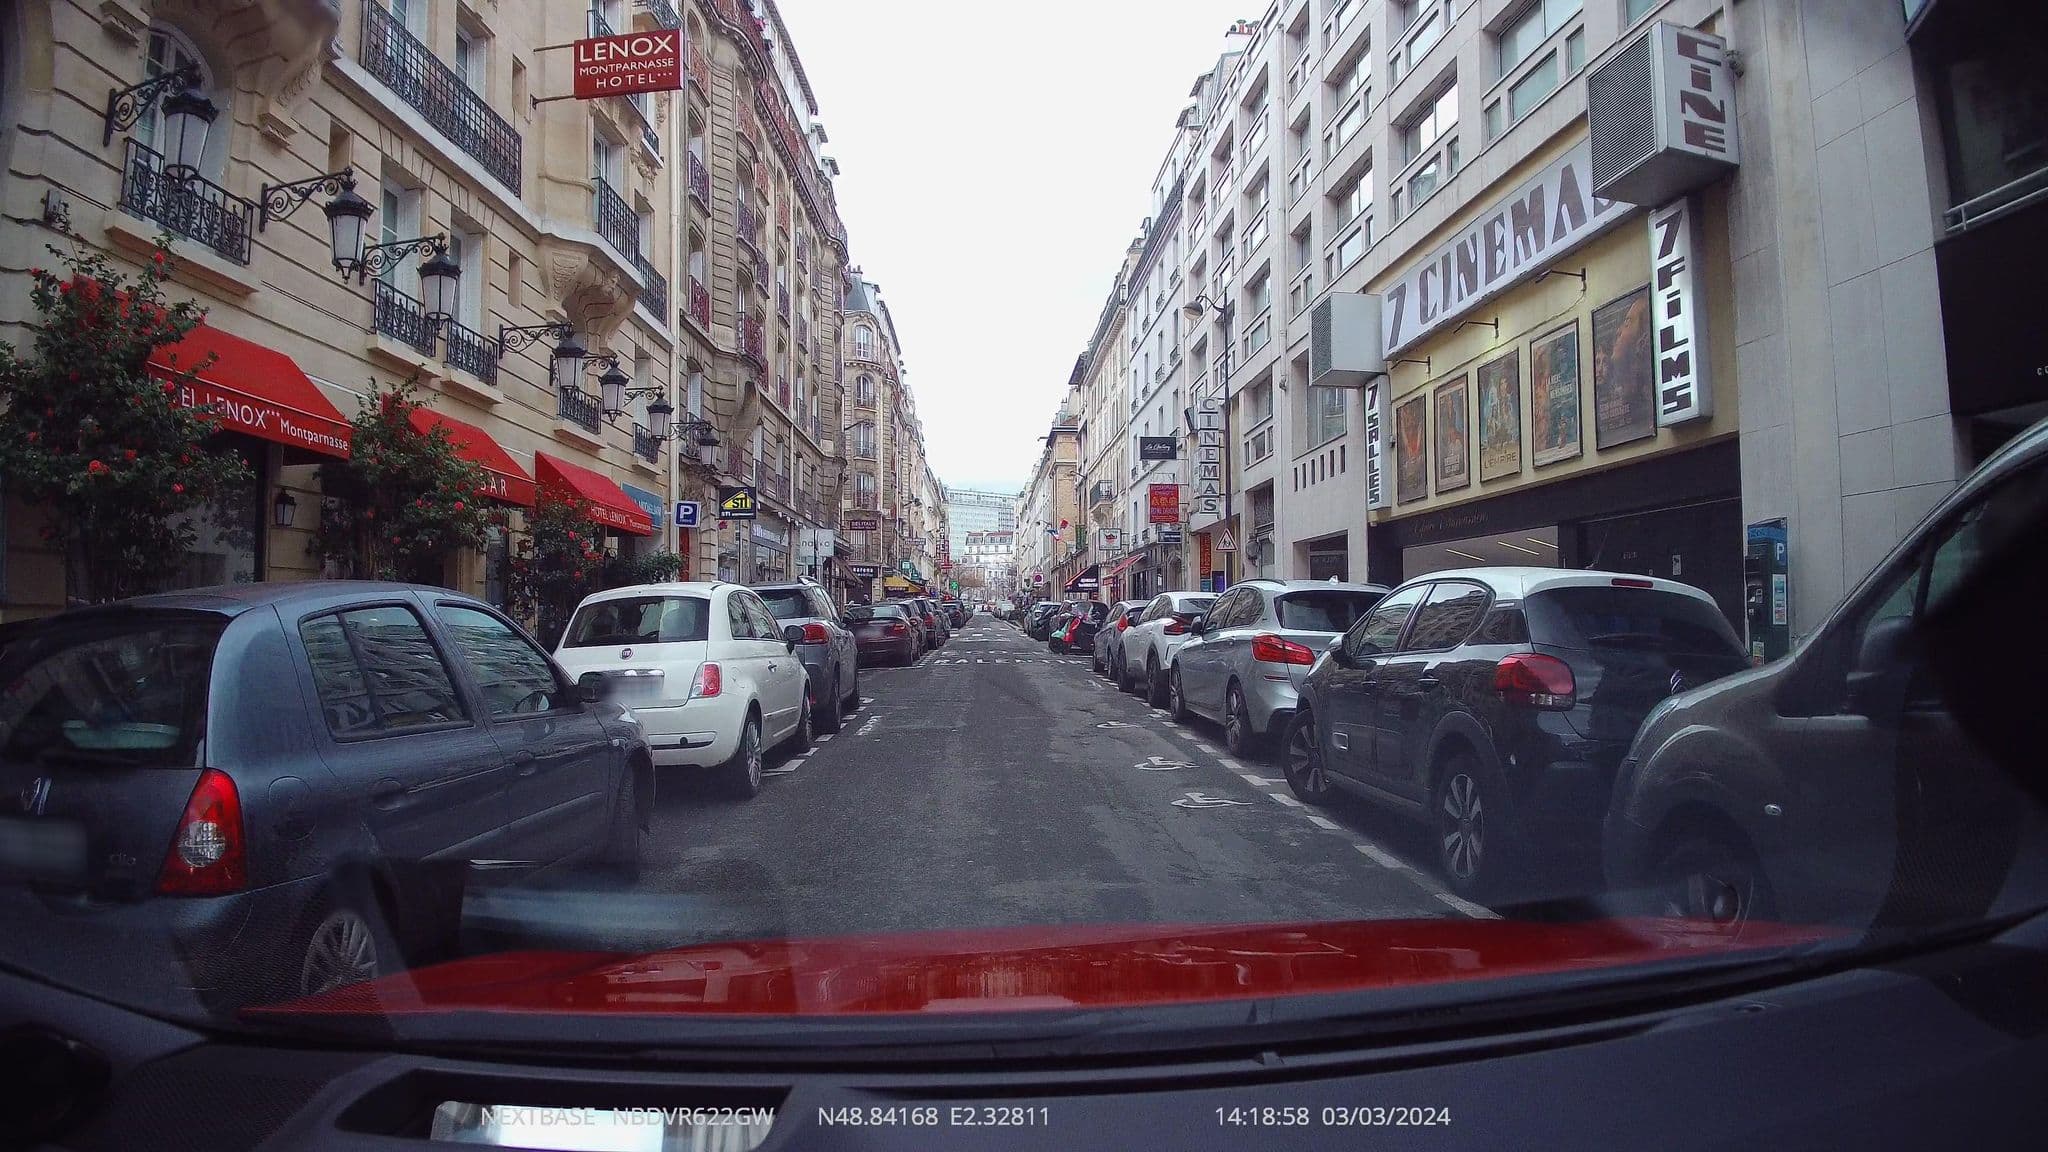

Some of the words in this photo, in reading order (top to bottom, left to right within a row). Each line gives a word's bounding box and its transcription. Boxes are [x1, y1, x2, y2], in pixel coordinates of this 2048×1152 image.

[580, 35, 673, 63] LENOX
[580, 58, 674, 76] MONTPARNASSE
[596, 73, 656, 89] HOTEL
[1655, 208, 1682, 260] 7
[1387, 282, 1407, 350] 7
[1419, 163, 1617, 325] CINEMA
[1367, 383, 1379, 411] 7
[280, 417, 348, 451] Montparnasse
[1202, 399, 1218, 511] CINEMAS
[1367, 412, 1380, 505] SALLES
[1484, 452, 1517, 469] L'EMPIRE
[609, 510, 626, 525] LENOX
[680, 505, 694, 519] P
[1776, 543, 1785, 561] P
